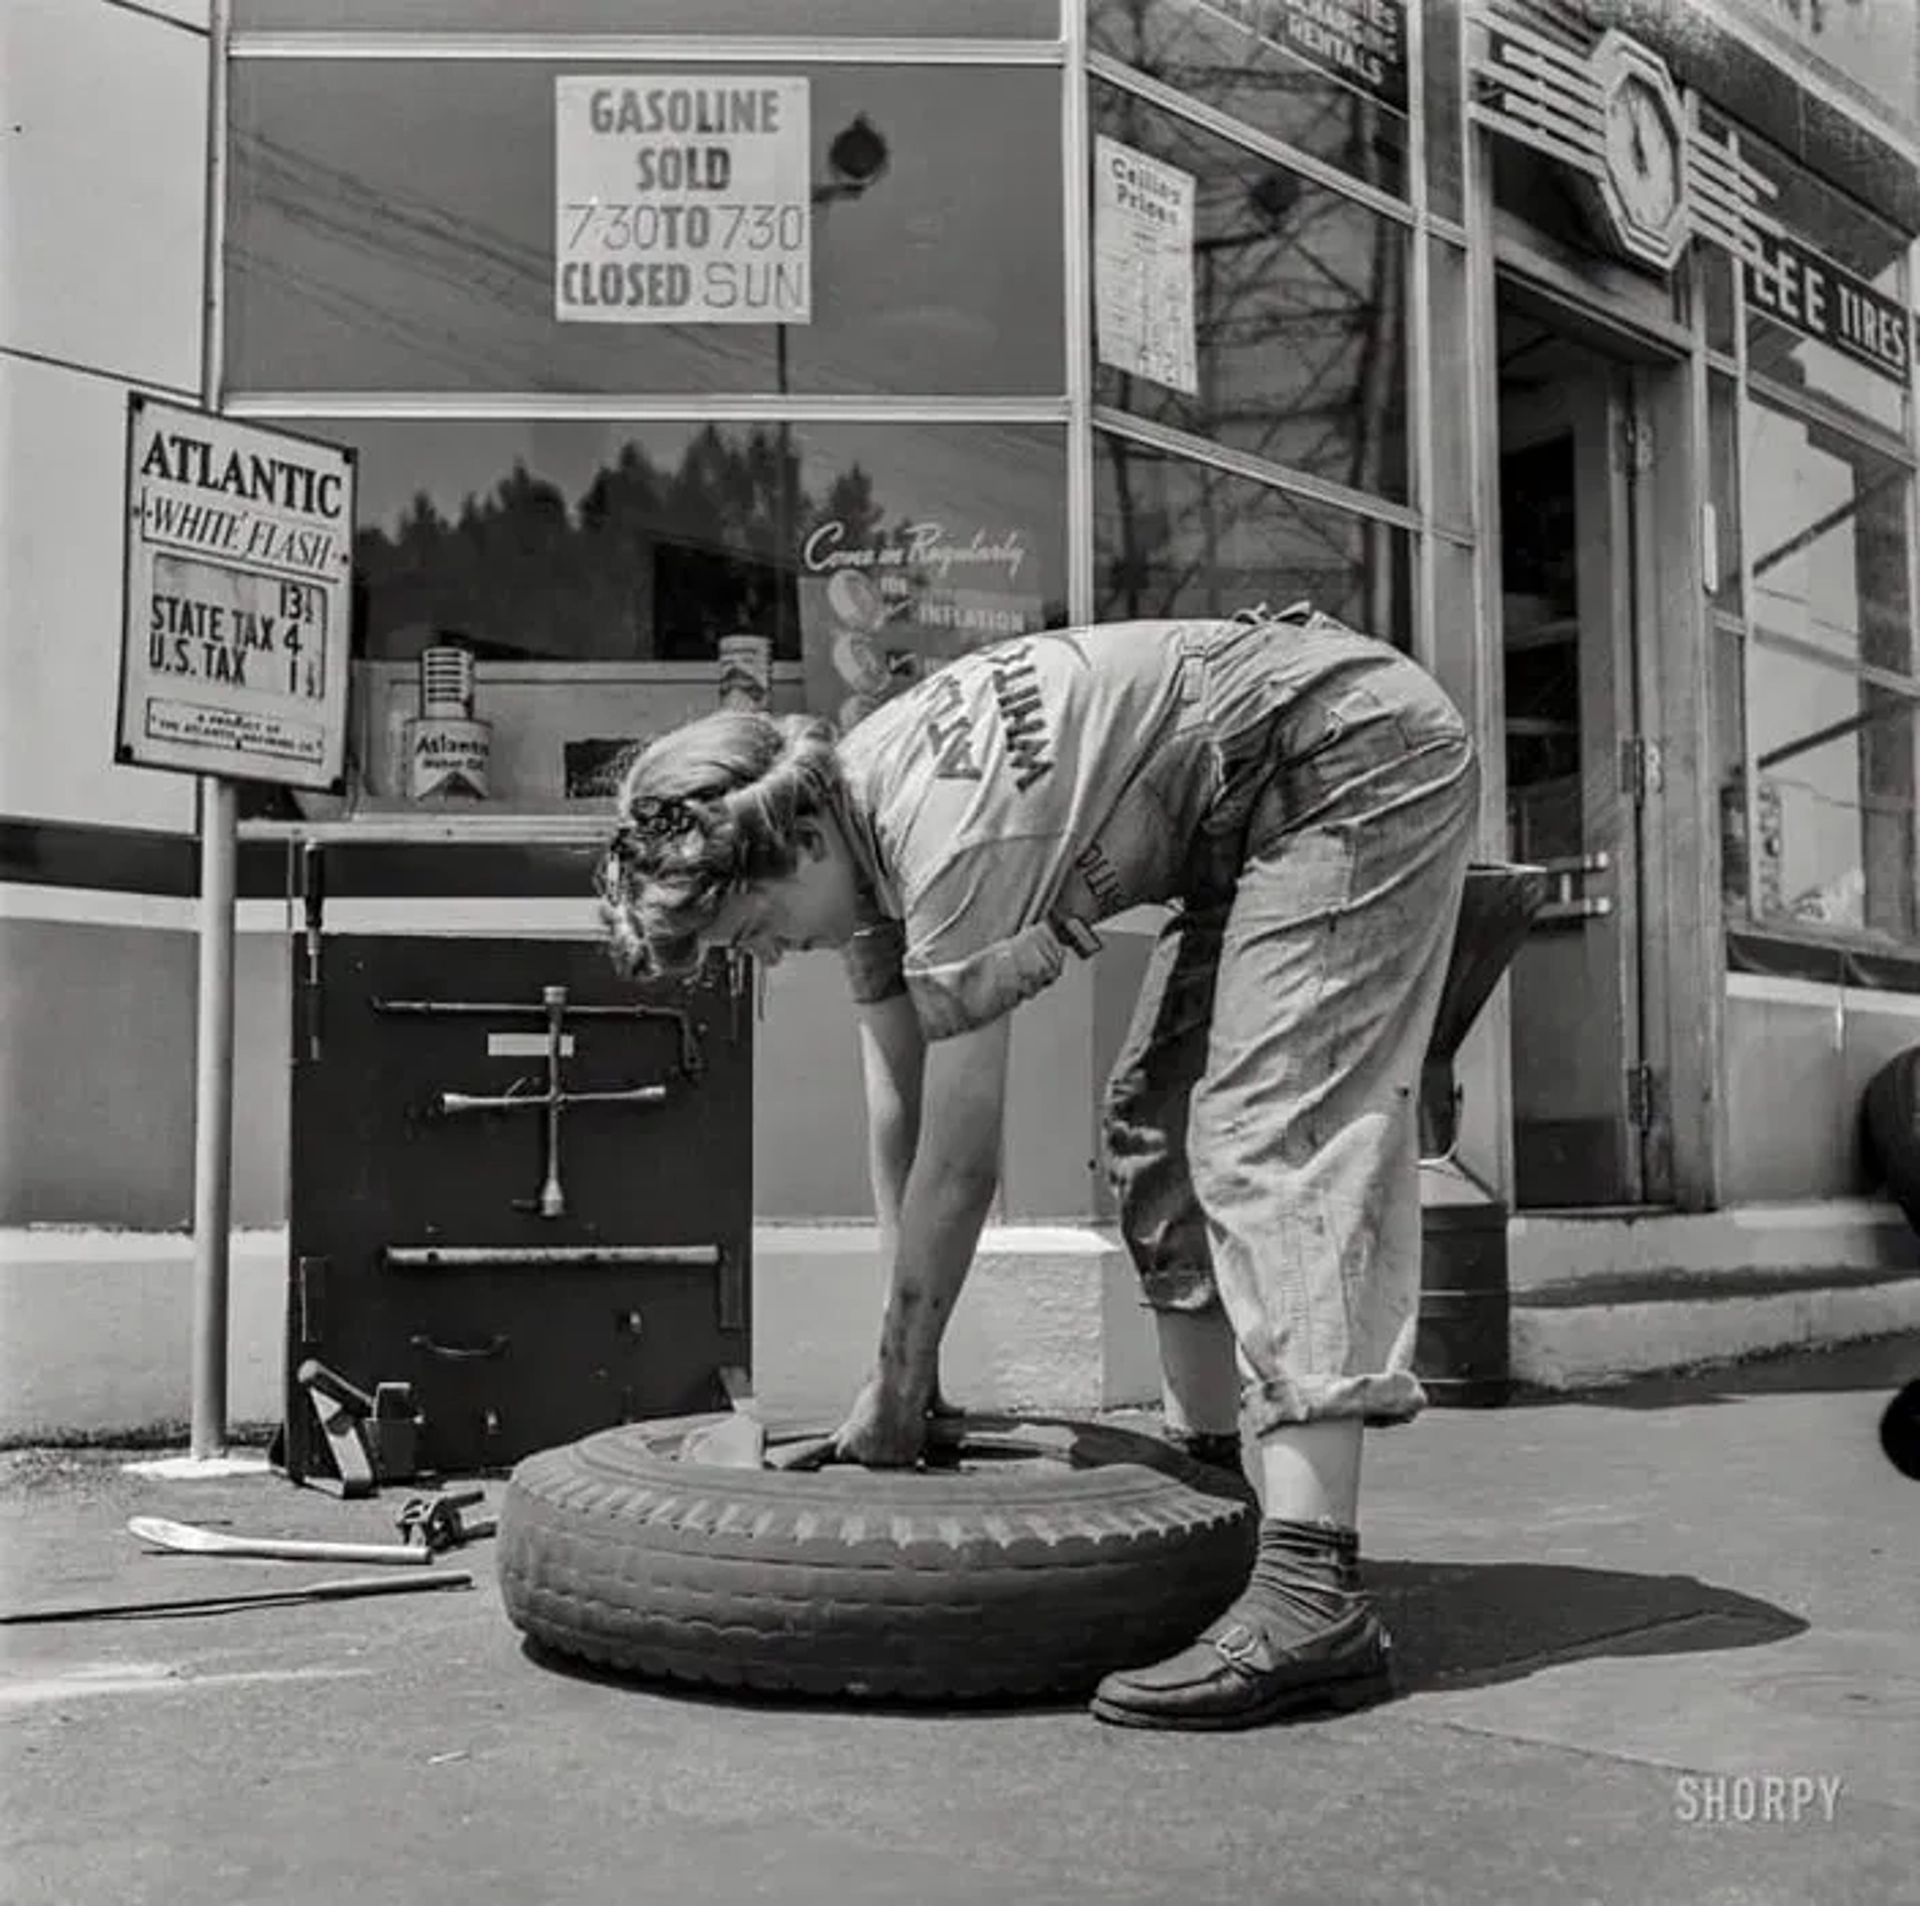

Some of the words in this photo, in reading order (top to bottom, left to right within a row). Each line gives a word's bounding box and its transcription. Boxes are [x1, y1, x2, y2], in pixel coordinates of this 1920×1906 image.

[590, 89, 779, 133] GASOLINE
[637, 147, 731, 190] SOLD
[659, 205, 709, 249] TO
[563, 263, 690, 306] CLOSED
[704, 262, 803, 309] SUN
[1755, 251, 1825, 333] LEE
[1838, 283, 1906, 368] TIRES
[141, 431, 342, 519] ATLANTIC
[154, 496, 240, 549] WHITE
[242, 520, 333, 570] FLASH
[151, 594, 224, 642] STATE
[232, 610, 275, 652] TAX
[284, 624, 303, 655] 4
[918, 599, 1026, 633] INFLATION
[149, 632, 197, 676] U.S.
[203, 642, 247, 686] TAX
